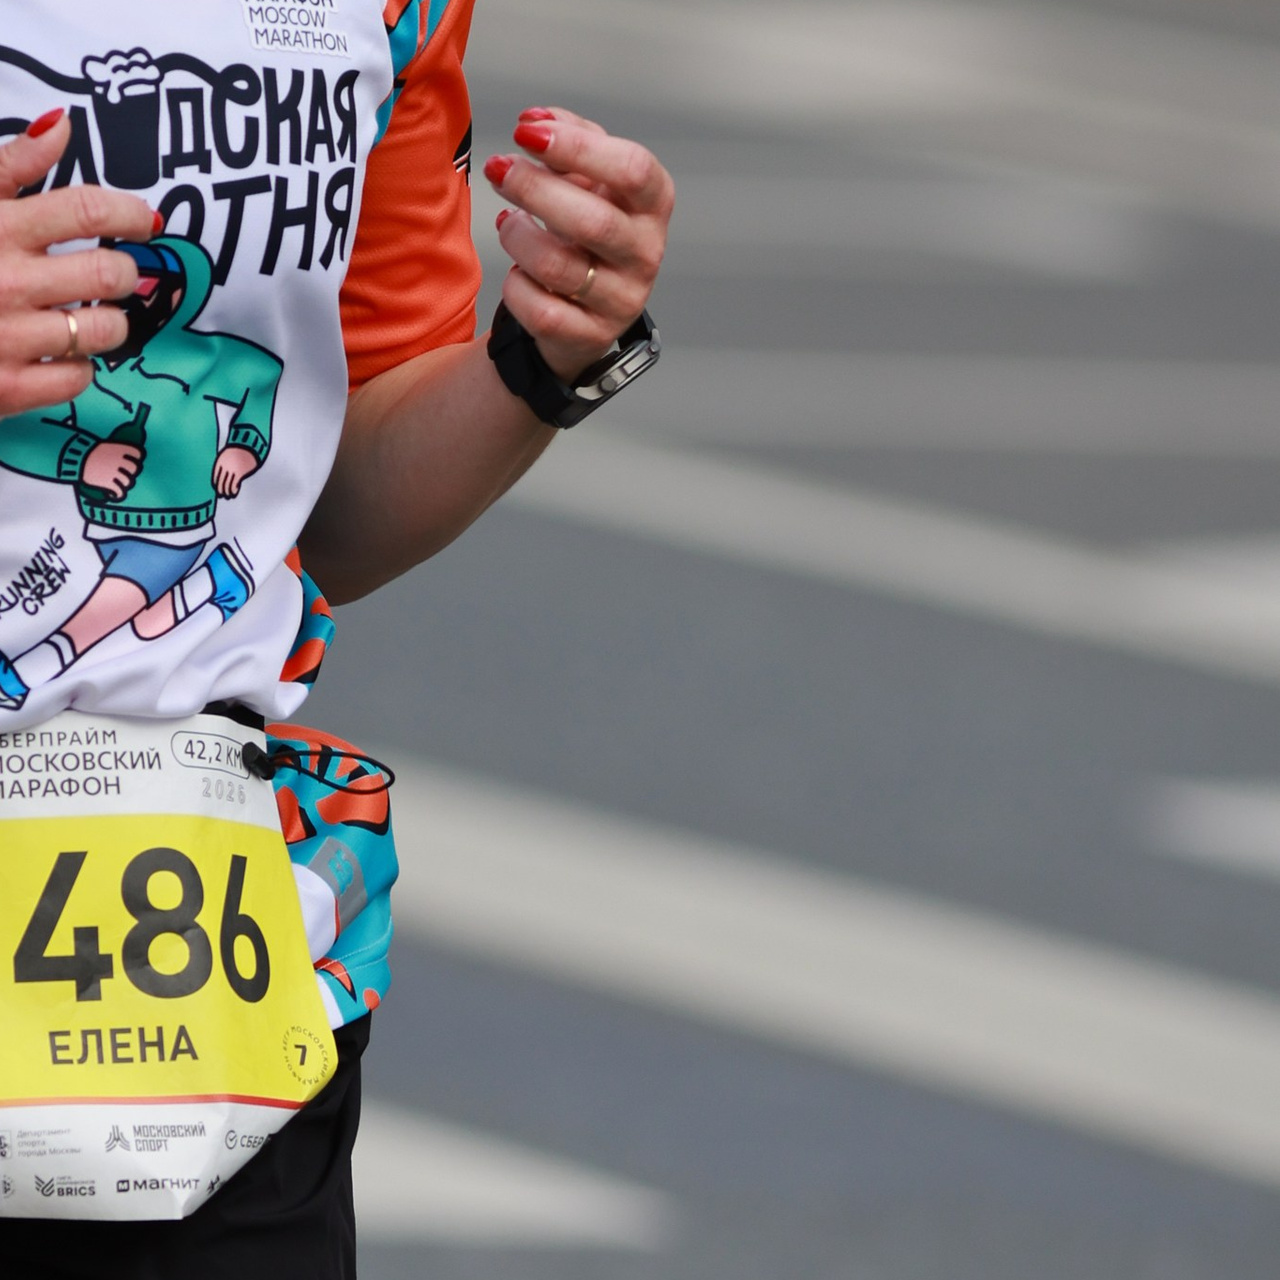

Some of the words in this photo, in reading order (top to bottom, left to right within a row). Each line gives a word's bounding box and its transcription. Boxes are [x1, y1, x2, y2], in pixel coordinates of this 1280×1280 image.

[249, 6, 326, 28] MOSCOW
[254, 28, 348, 52] MARATHON
[22, 556, 71, 616] CREW
[184, 739, 223, 764] 42,2
[47, 1023, 200, 1067] ЕЛЕНА
[294, 1044, 308, 1067] 7
[132, 1122, 207, 1139] МОСКОВСКИЙ
[135, 1139, 169, 1152] СПОРТ
[57, 1186, 96, 1197] BRICS
